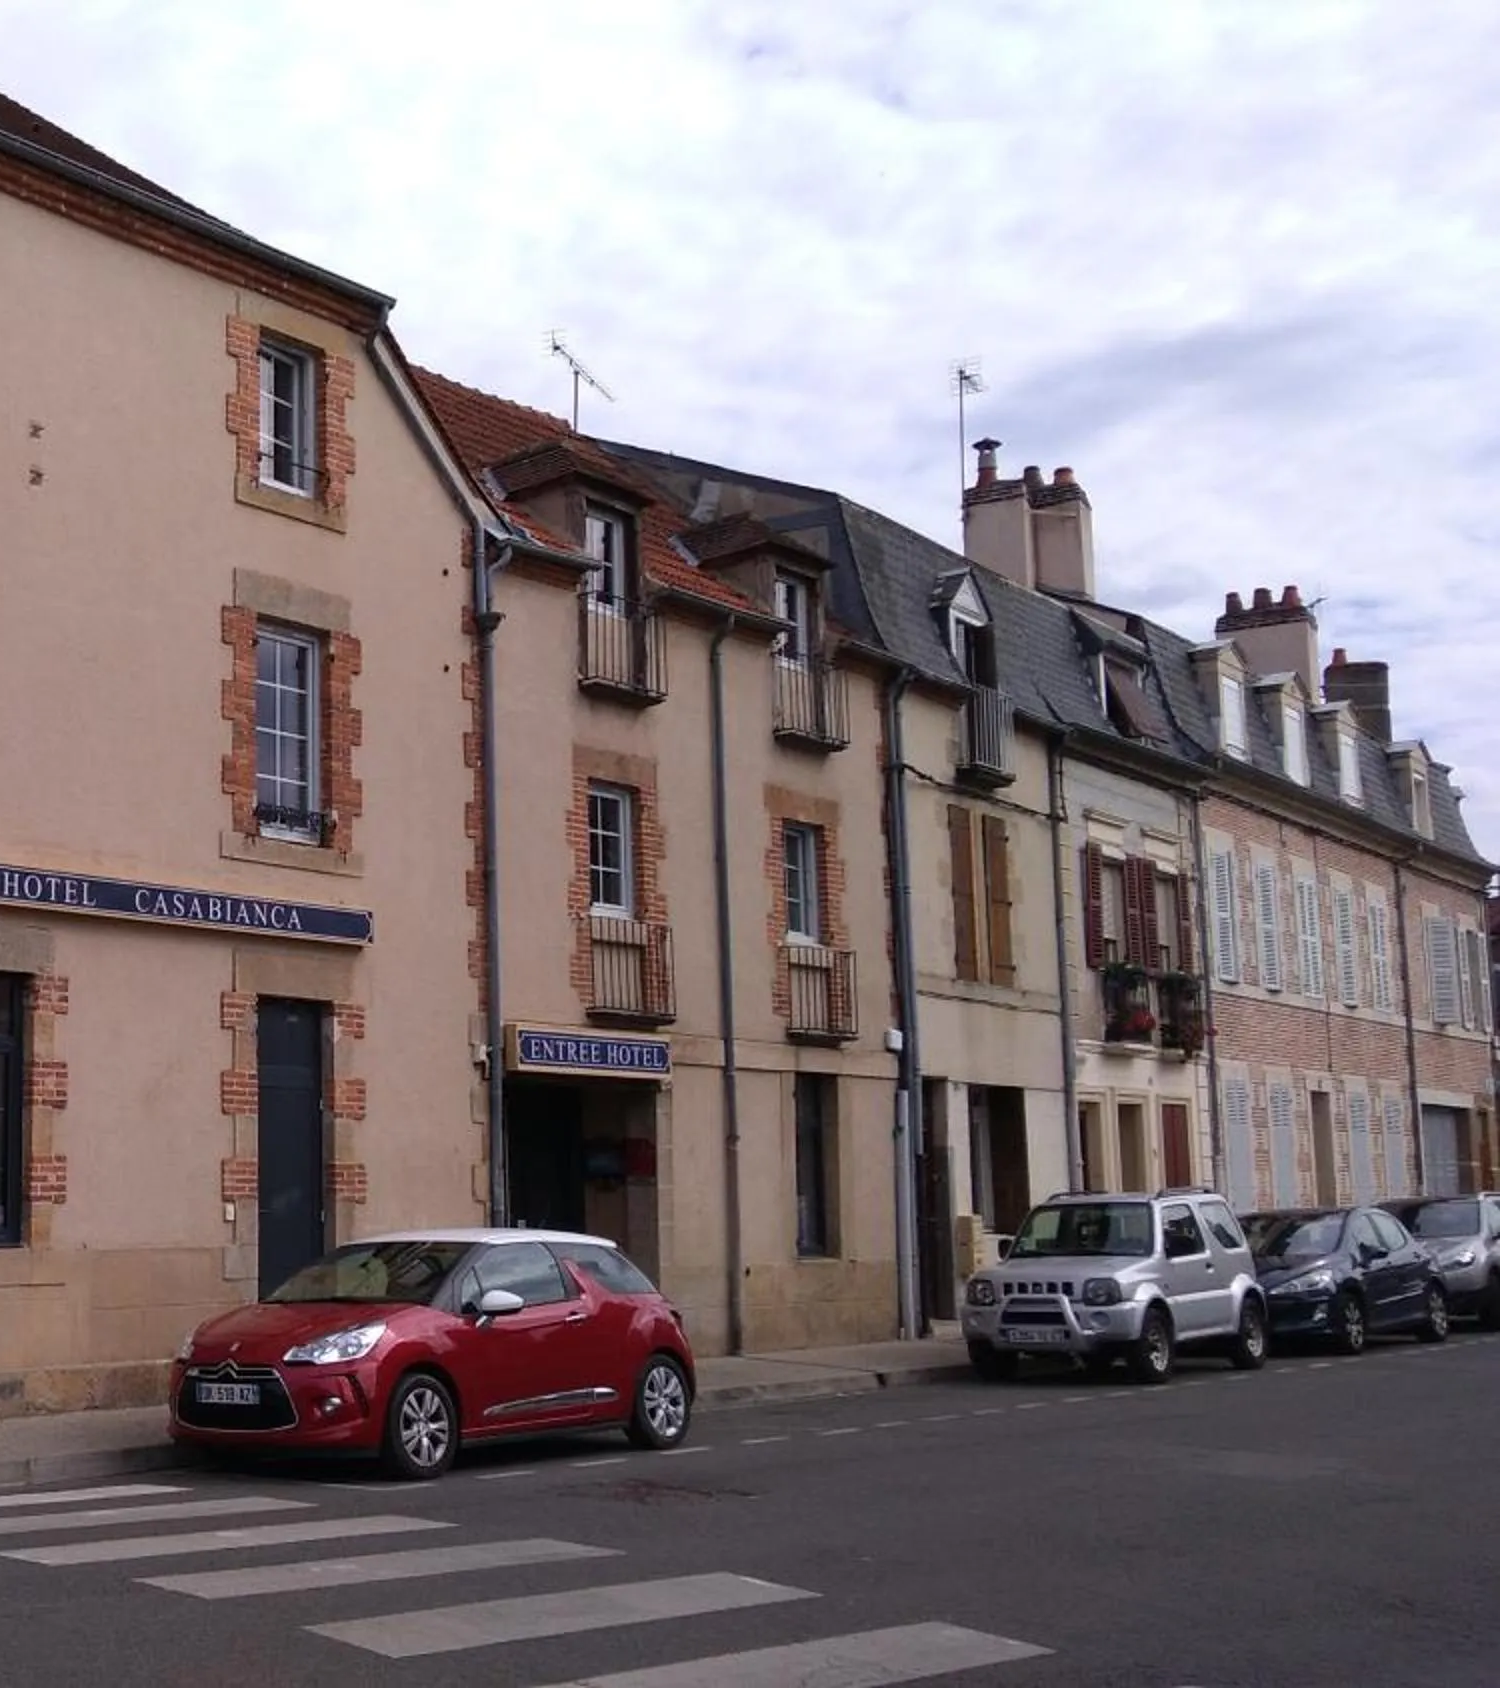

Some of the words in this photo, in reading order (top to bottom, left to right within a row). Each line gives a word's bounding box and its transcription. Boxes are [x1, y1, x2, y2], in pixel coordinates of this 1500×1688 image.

[3, 872, 97, 907] HOTEL
[135, 889, 303, 929] CASABIANCA
[530, 1039, 600, 1062] ENTREE
[607, 1044, 664, 1067] HOTEL
